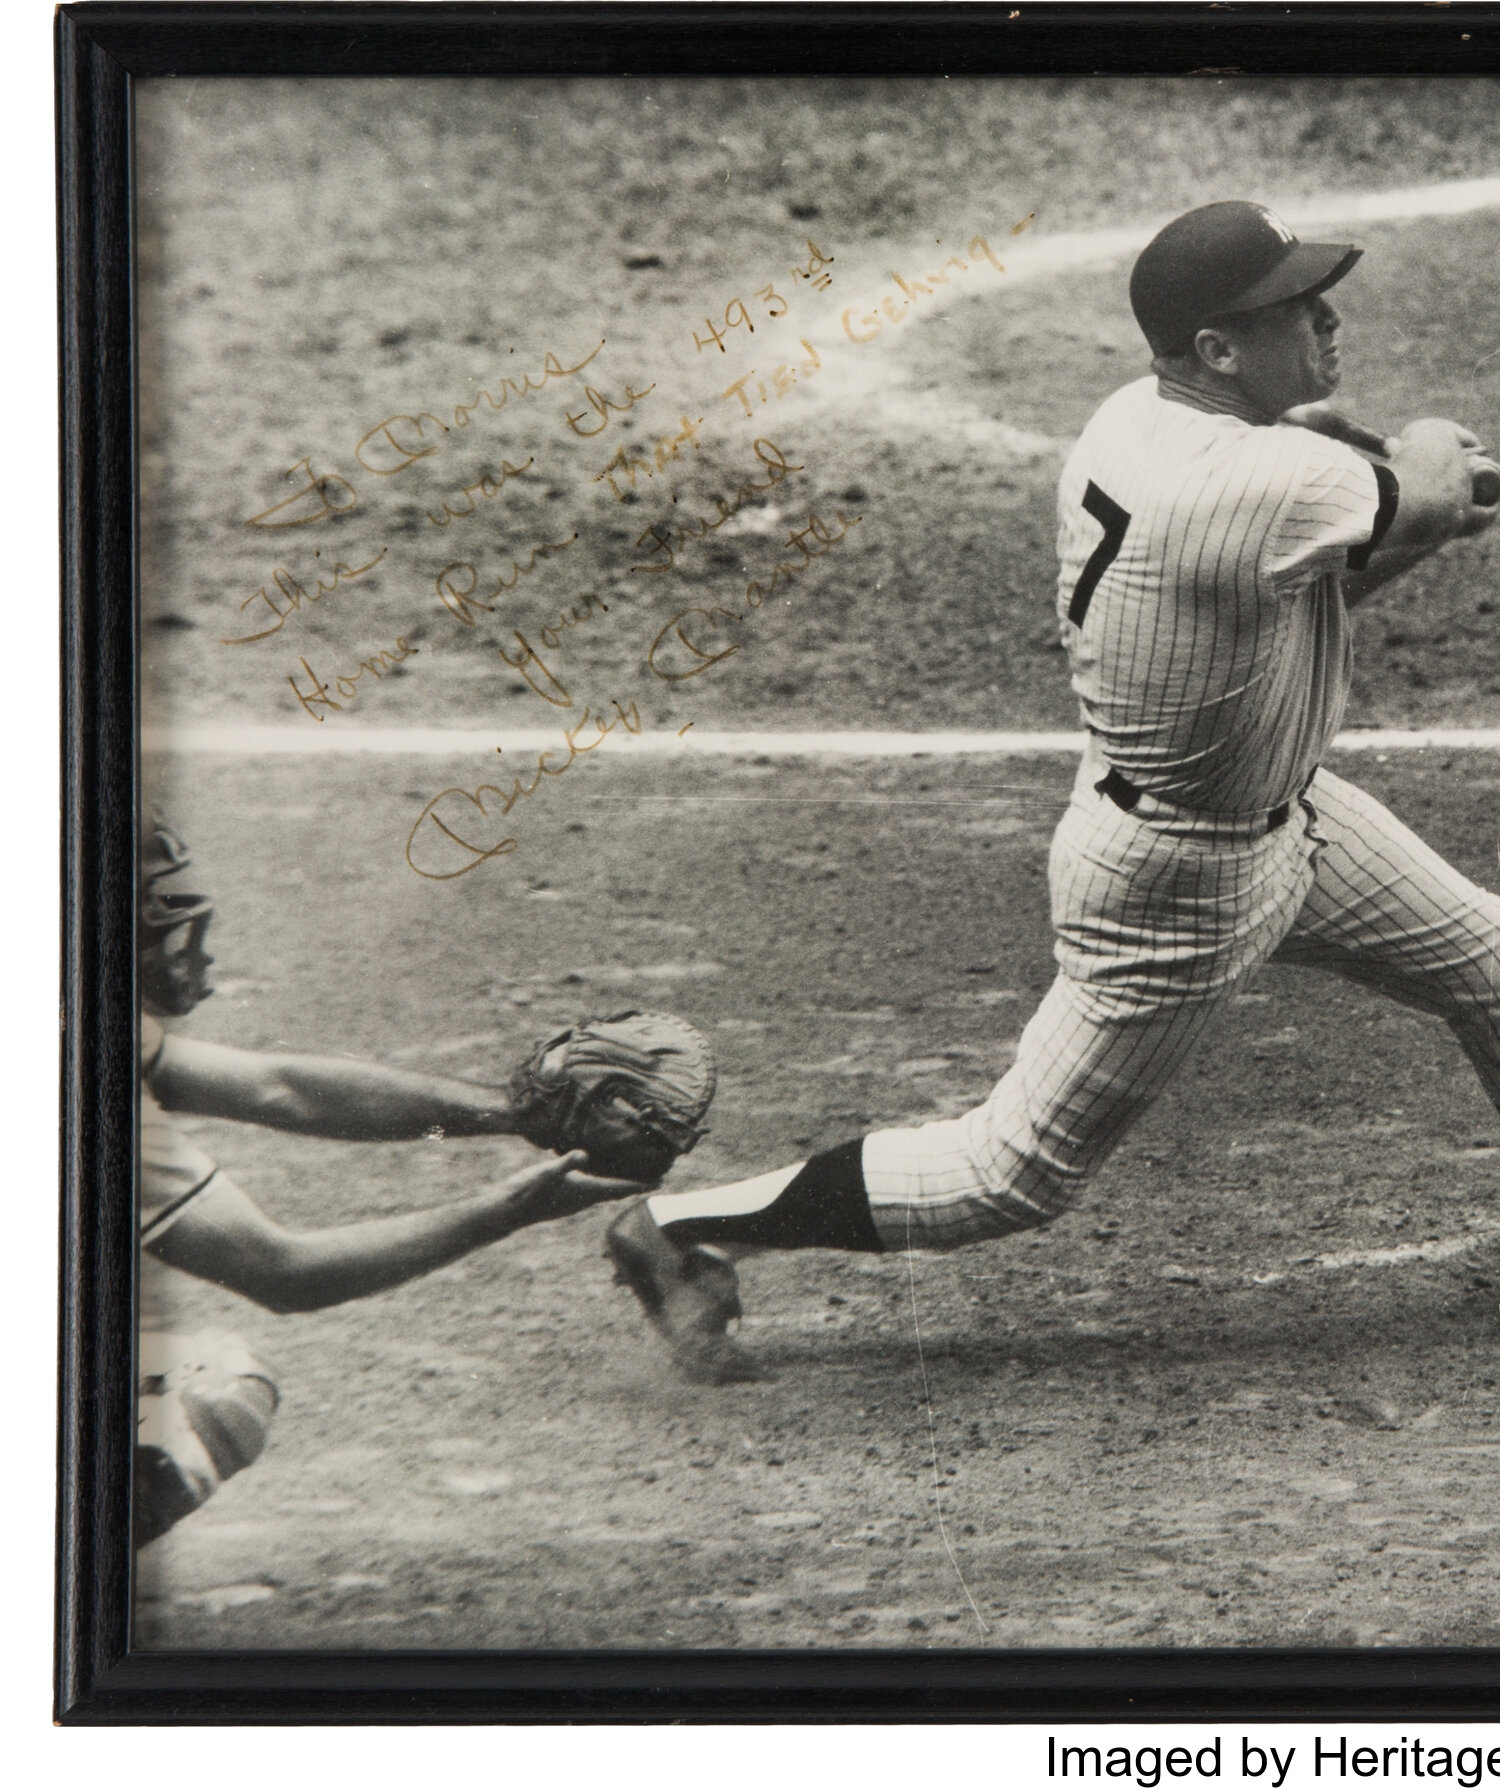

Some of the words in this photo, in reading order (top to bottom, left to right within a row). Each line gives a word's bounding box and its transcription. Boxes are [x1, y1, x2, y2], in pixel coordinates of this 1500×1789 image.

[219, 546, 388, 646] This
[427, 456, 534, 527] was
[566, 385, 656, 438] the
[1067, 478, 1132, 630] 7
[286, 636, 419, 722] Home
[436, 531, 579, 627] Run
